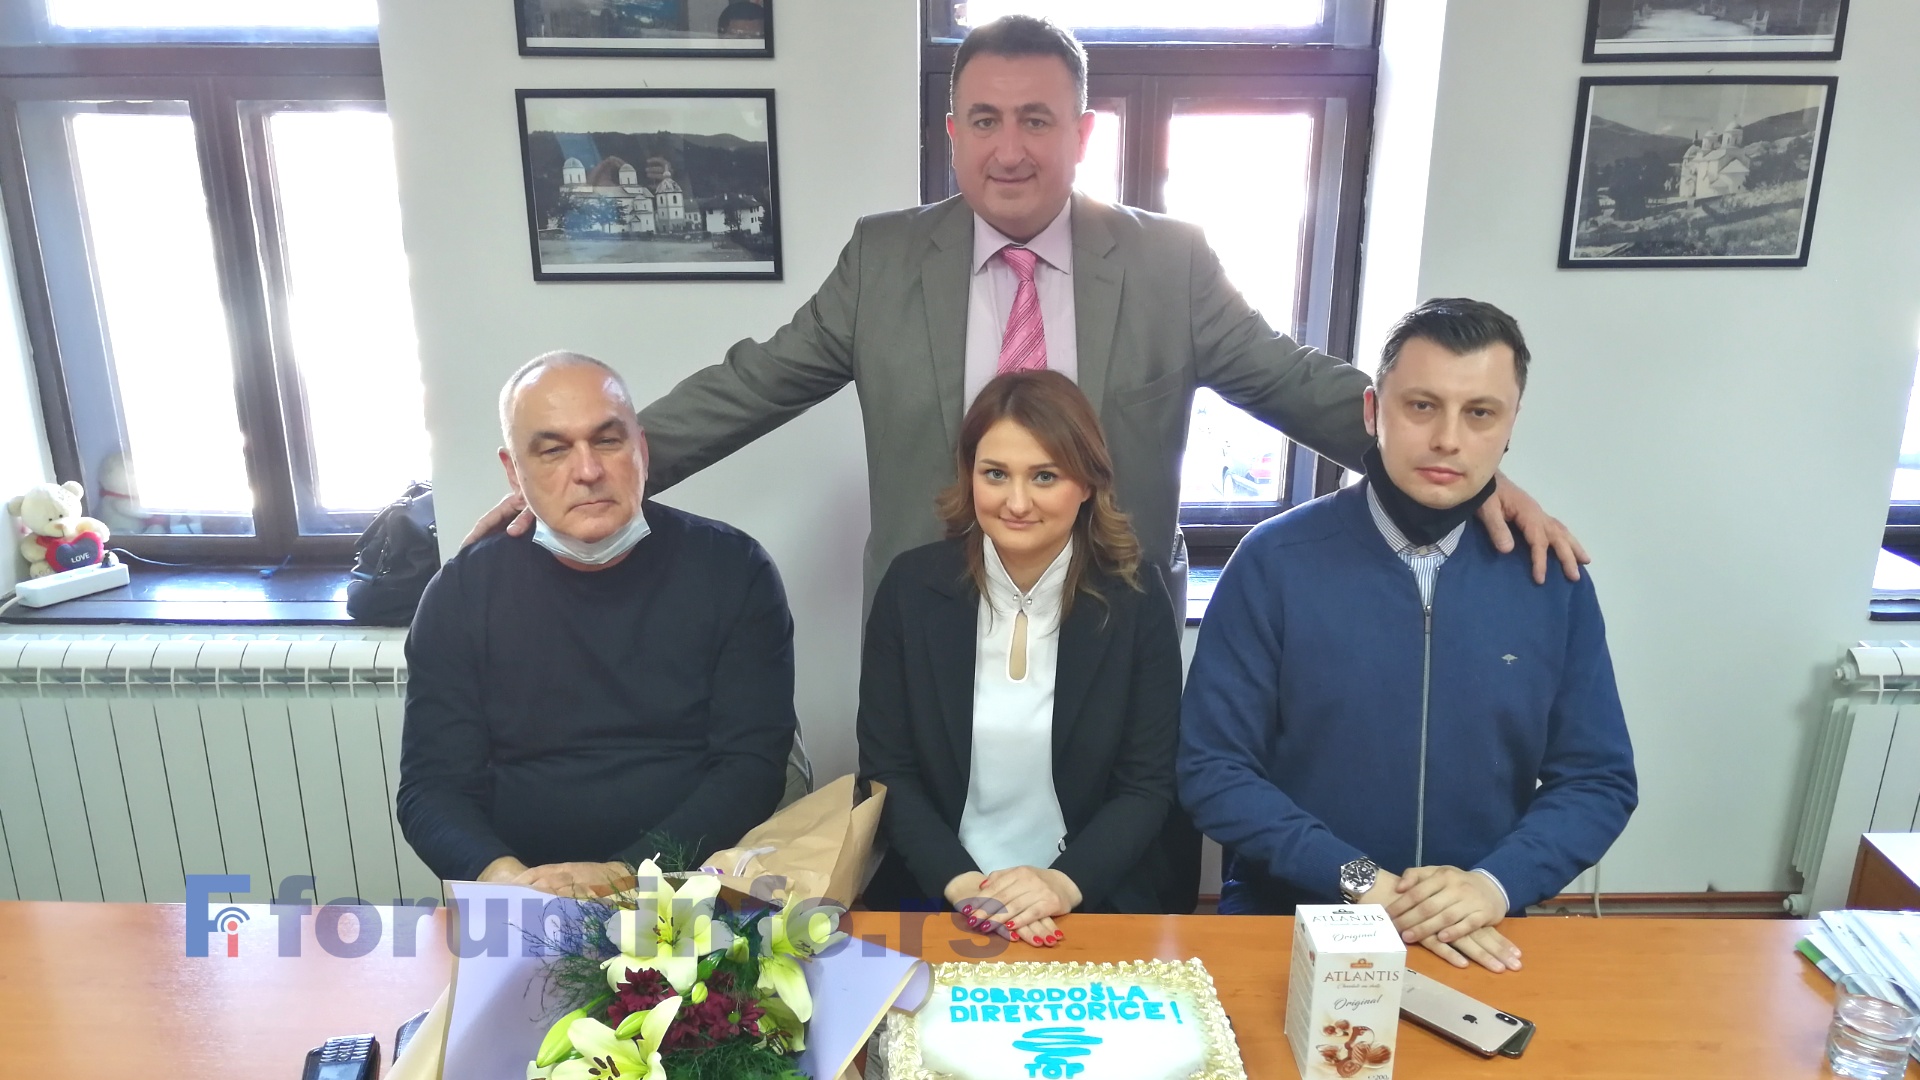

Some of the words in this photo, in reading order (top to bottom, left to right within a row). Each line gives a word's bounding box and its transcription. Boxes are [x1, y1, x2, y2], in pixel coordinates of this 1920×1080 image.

[71, 552, 90, 563] LOVE
[1312, 914, 1385, 923] ATLANTIS
[1332, 930, 1377, 943] Original
[1323, 970, 1399, 983] ATLANTIS
[951, 982, 1149, 1003] DOBRODOŠLA
[1334, 994, 1383, 1011] Original
[1023, 1062, 1085, 1080] TOP
